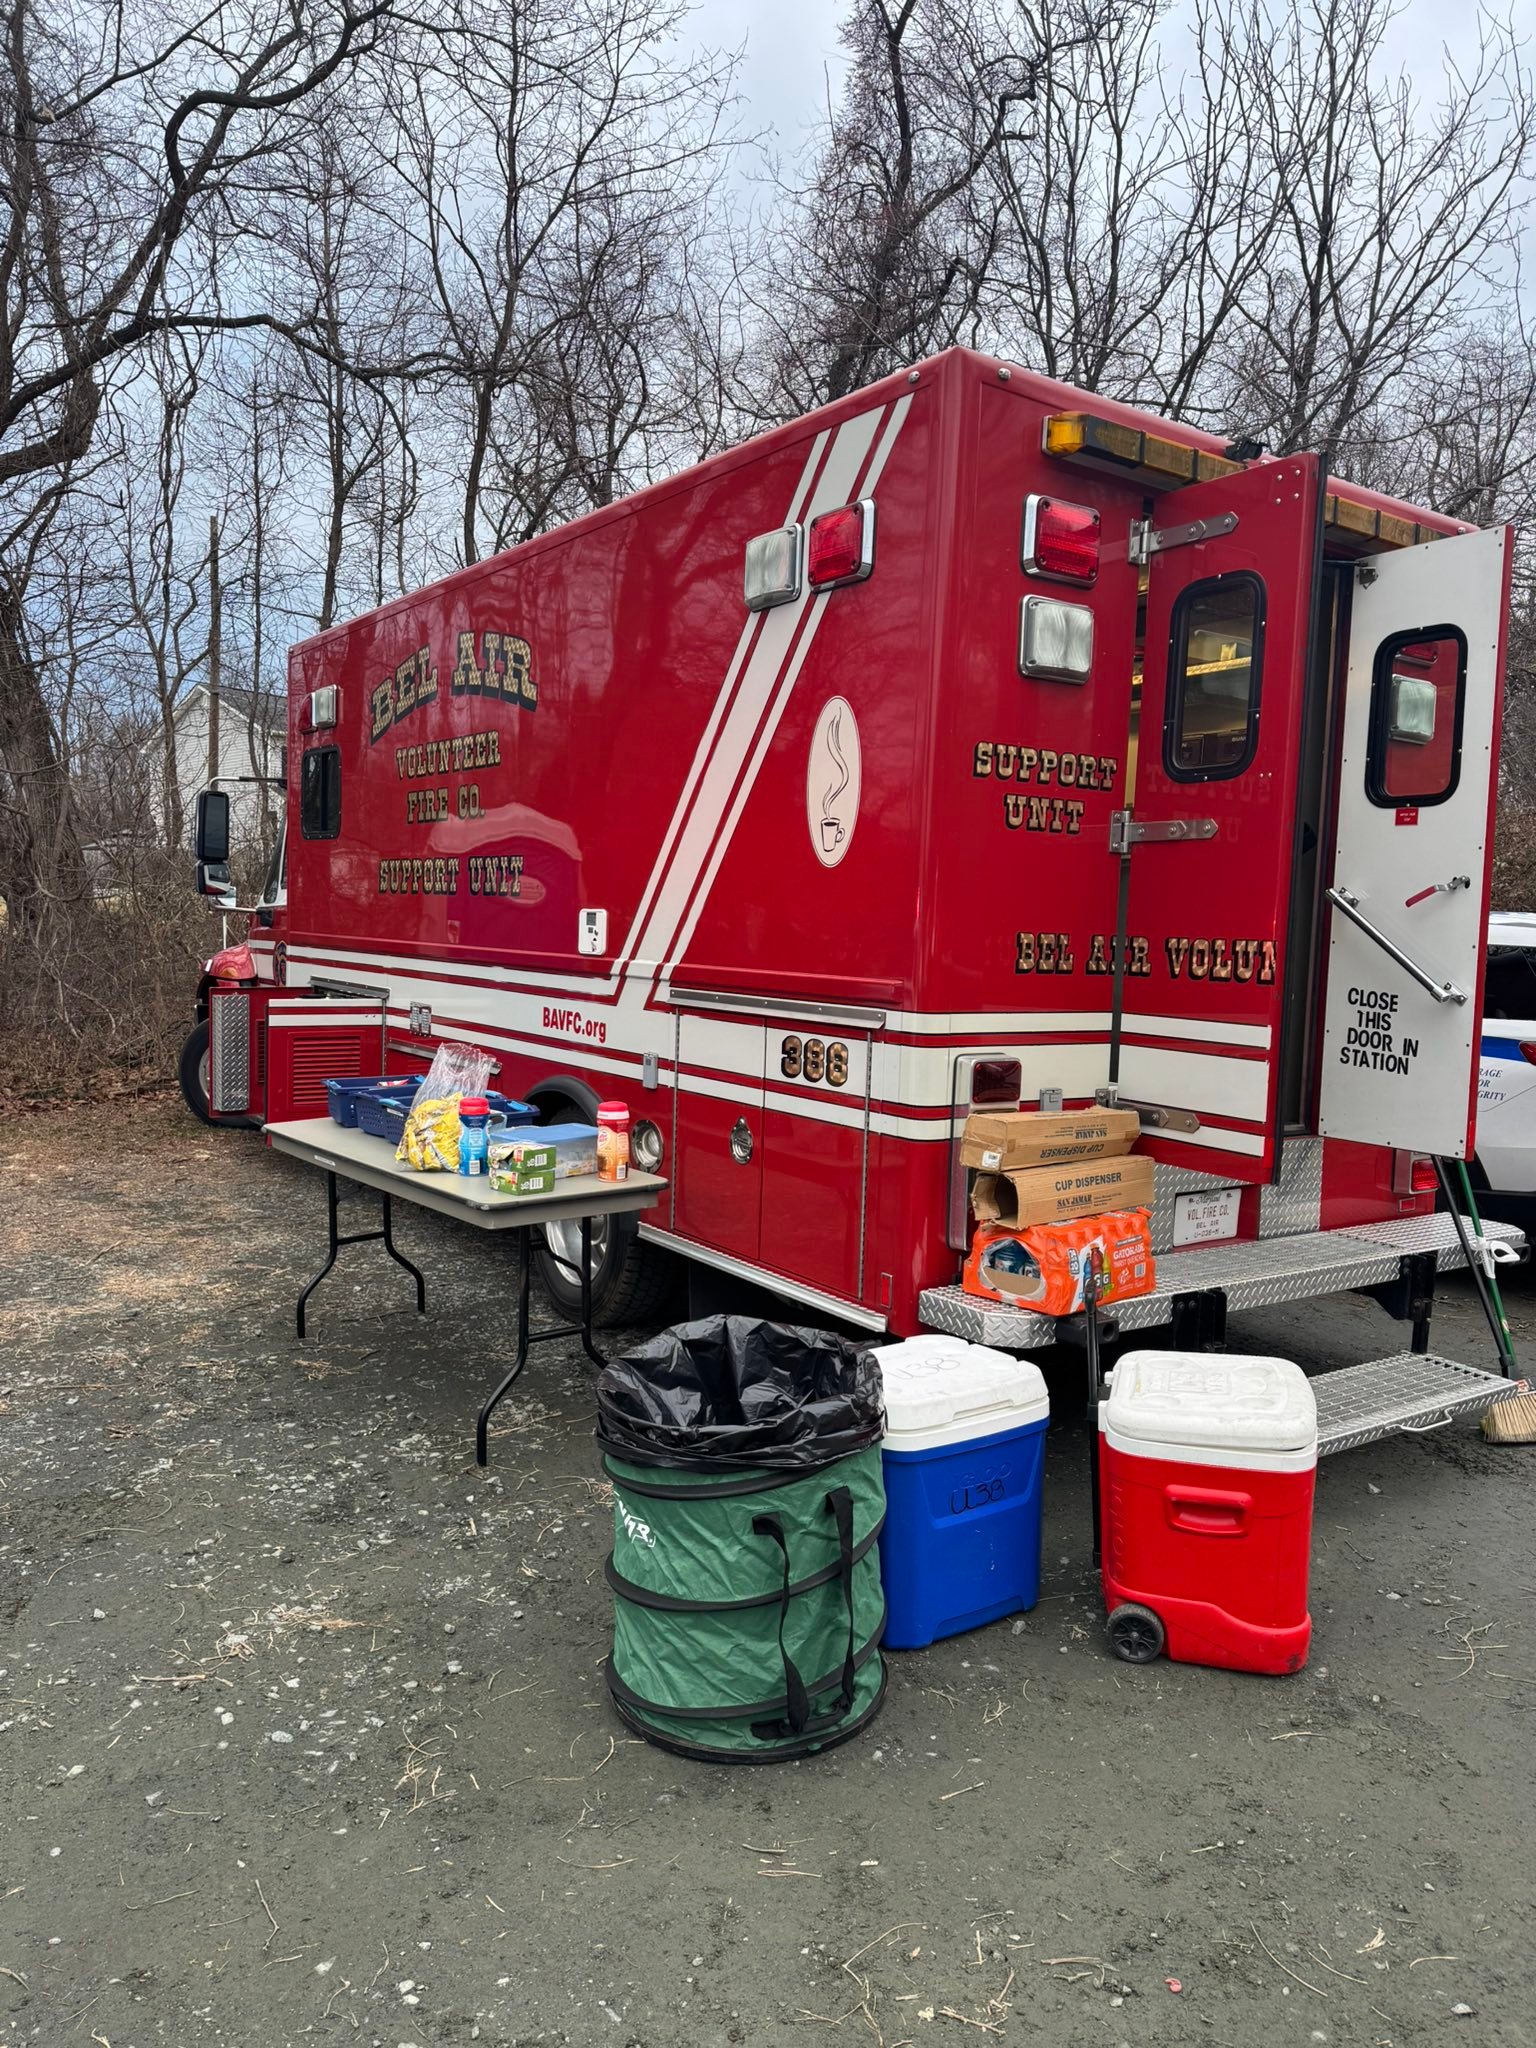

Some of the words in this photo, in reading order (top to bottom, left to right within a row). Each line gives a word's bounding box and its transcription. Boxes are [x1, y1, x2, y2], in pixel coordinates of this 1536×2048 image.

[371, 644, 438, 746] BEL
[452, 630, 538, 712] AIR
[396, 730, 501, 780] VOLUNTEER
[973, 740, 1119, 791] SUPPORT
[407, 787, 448, 824] FIRE
[458, 783, 485, 820] CO.
[1004, 793, 1084, 834] UNIT
[379, 857, 459, 894] SUPPORT
[469, 855, 523, 896] UNIT
[1015, 932, 1074, 974] BEL
[1348, 987, 1398, 1012] CLOSE
[543, 1006, 606, 1043] BAVFC.org
[1357, 1010, 1392, 1031] THIS
[1340, 1046, 1408, 1075] STATION
[1347, 1027, 1392, 1052] DOOR
[1403, 1038, 1418, 1057] IN
[781, 1035, 848, 1087] 388
[1040, 1145, 1086, 1158] DISPENSER
[1088, 1144, 1104, 1153] CUP
[1055, 1179, 1072, 1191] CUP
[1076, 1172, 1122, 1188] DISPENSER
[952, 1479, 1005, 1514] U38
